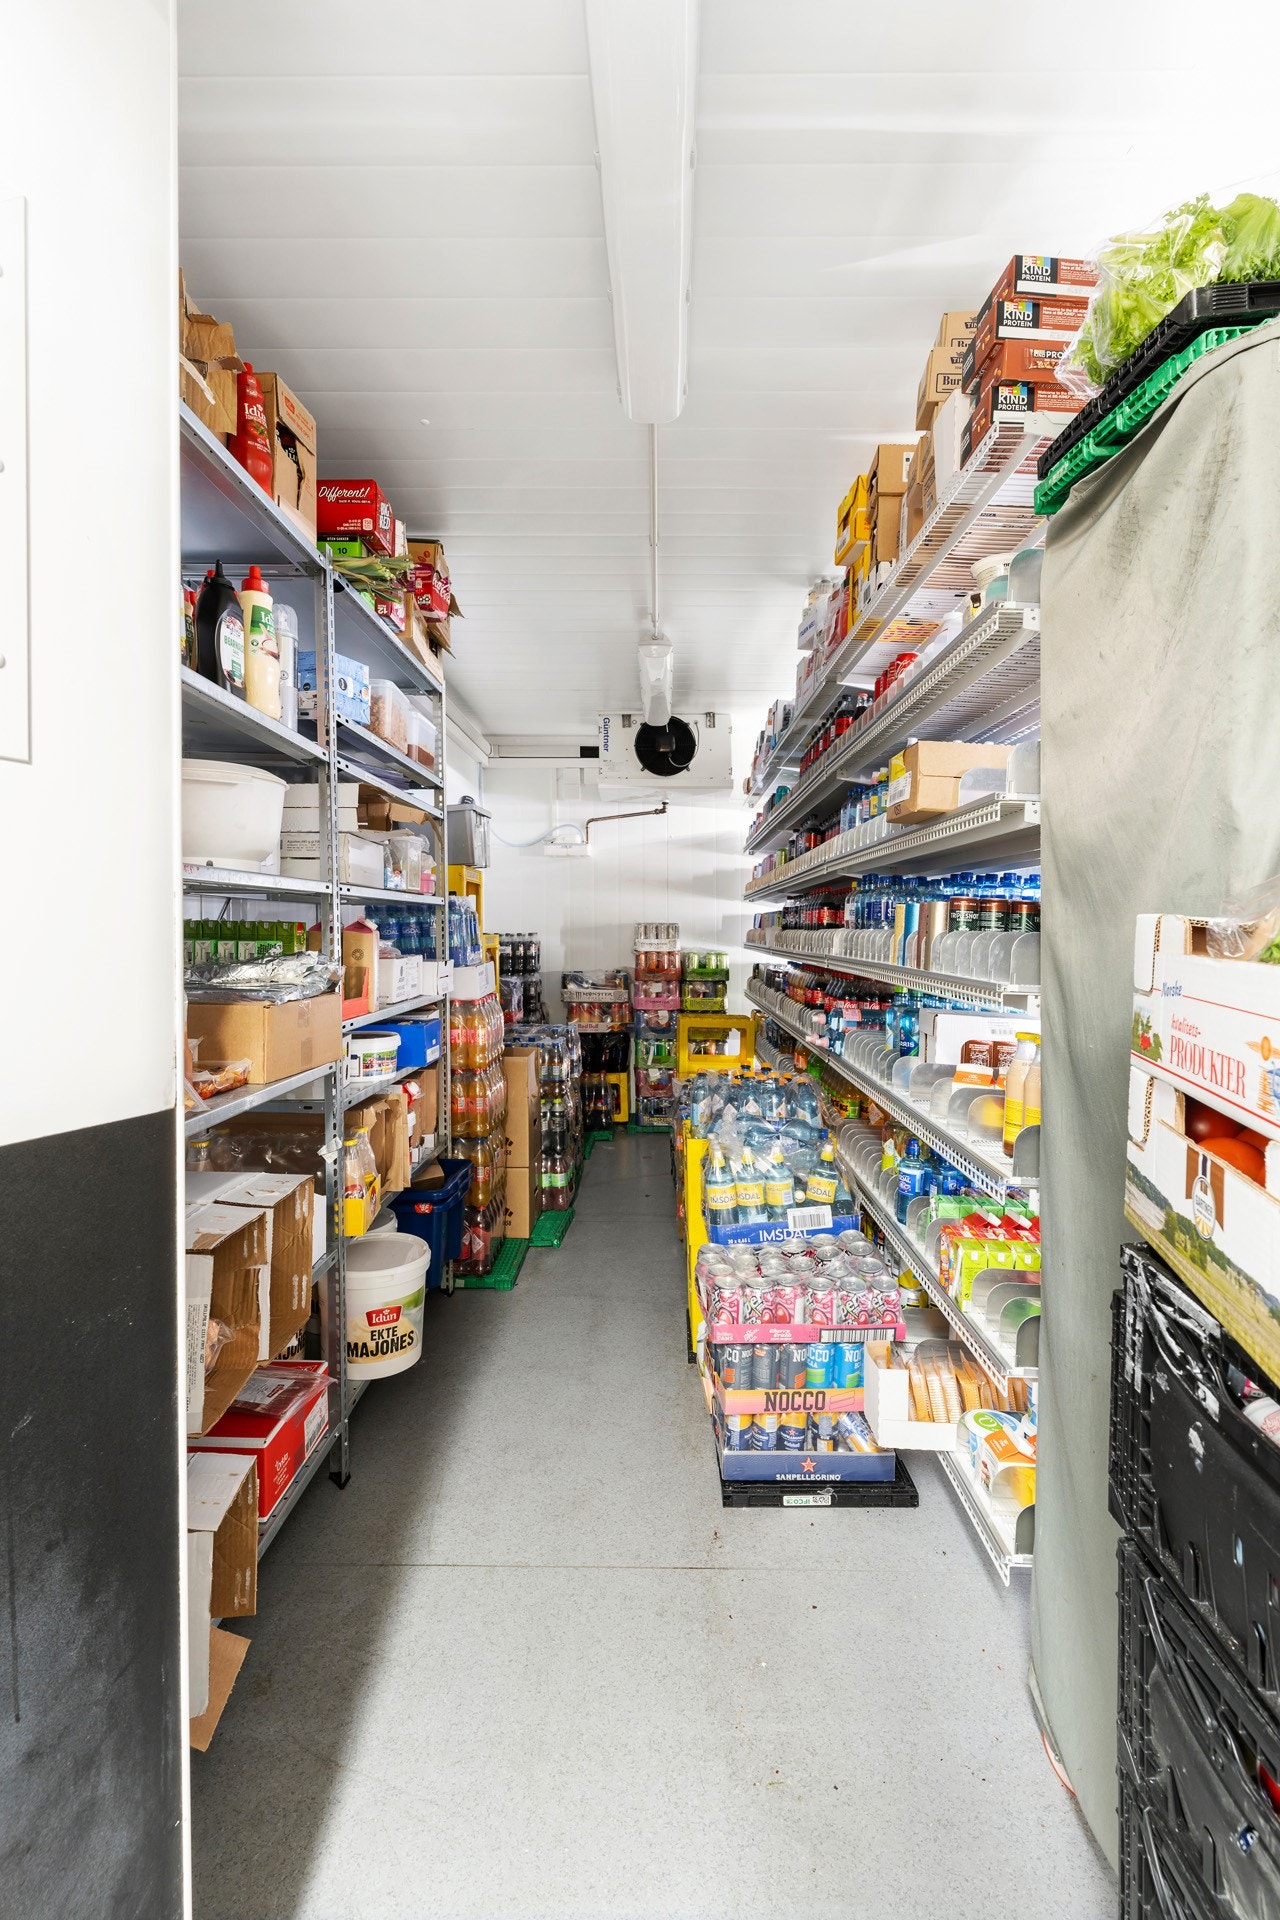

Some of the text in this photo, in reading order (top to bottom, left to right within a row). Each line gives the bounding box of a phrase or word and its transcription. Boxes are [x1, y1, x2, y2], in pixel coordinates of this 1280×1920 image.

[1022, 265, 1051, 276] KIND
[1021, 273, 1051, 282] PROTEIN
[1003, 310, 1033, 321] KIND
[1003, 319, 1033, 328] PROTEIN
[998, 395, 1028, 405] KIND
[997, 403, 1028, 411] PROTEIN
[318, 486, 371, 502] Different!
[380, 502, 393, 517] BIG
[379, 515, 391, 530] RED
[337, 547, 348, 555] 10
[377, 607, 388, 615] 12
[603, 717, 611, 752] Güntner
[1161, 980, 1182, 997] Norske
[1169, 1034, 1246, 1099] PRODUKTER
[758, 1228, 812, 1242] IMSDAL
[371, 1312, 398, 1324] Idun
[370, 1325, 398, 1342] EKTE
[346, 1330, 415, 1358] MAJONES
[763, 1390, 826, 1412] NOCCO
[776, 1473, 841, 1481] SANPELLEGRINO
